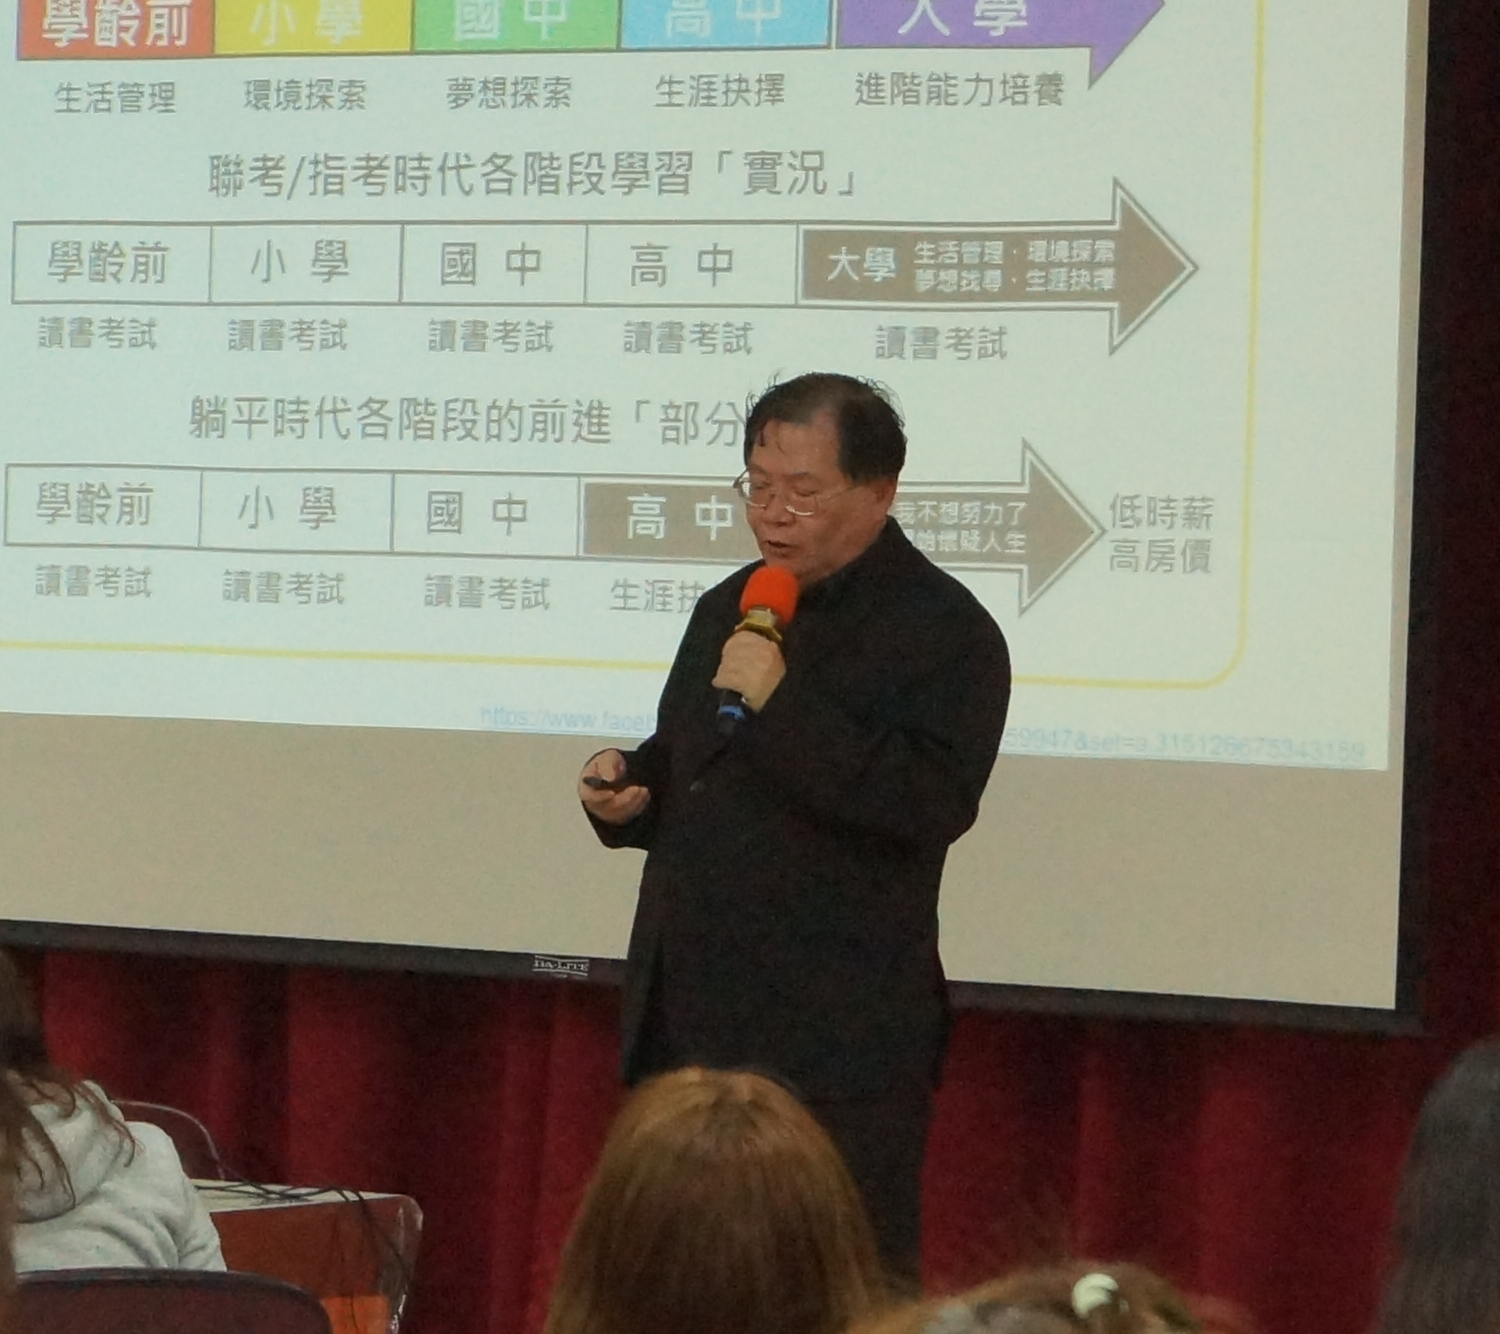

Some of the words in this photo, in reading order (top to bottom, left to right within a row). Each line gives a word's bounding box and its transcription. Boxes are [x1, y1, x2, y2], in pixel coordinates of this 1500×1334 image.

[54, 80, 177, 115] 生活管理
[243, 78, 367, 112] 環境探索
[445, 76, 573, 112] 夢想探索
[654, 72, 785, 108] 生涯抉擇
[854, 71, 1066, 108] 進階能力培養
[47, 240, 169, 285] 學齡前
[250, 238, 350, 284] 小學
[440, 241, 542, 287] 國中
[630, 241, 733, 288] 高中
[827, 246, 898, 283] 大學
[38, 316, 157, 351] 讀書考試
[228, 318, 348, 354] 讀書考試
[428, 318, 555, 354] 讀書考試
[624, 321, 753, 357] 讀書考試
[875, 325, 1008, 361] 讀書考試
[36, 482, 154, 527] 學齡前
[238, 485, 338, 531] 小學
[426, 490, 529, 537] 國中
[627, 492, 734, 542] 高中
[1108, 493, 1216, 532] 低時薪
[1108, 537, 1214, 575] 高房價
[35, 564, 153, 600] 讀書考試
[222, 570, 346, 607] 讀書考試
[424, 575, 551, 612] 讀書考試
